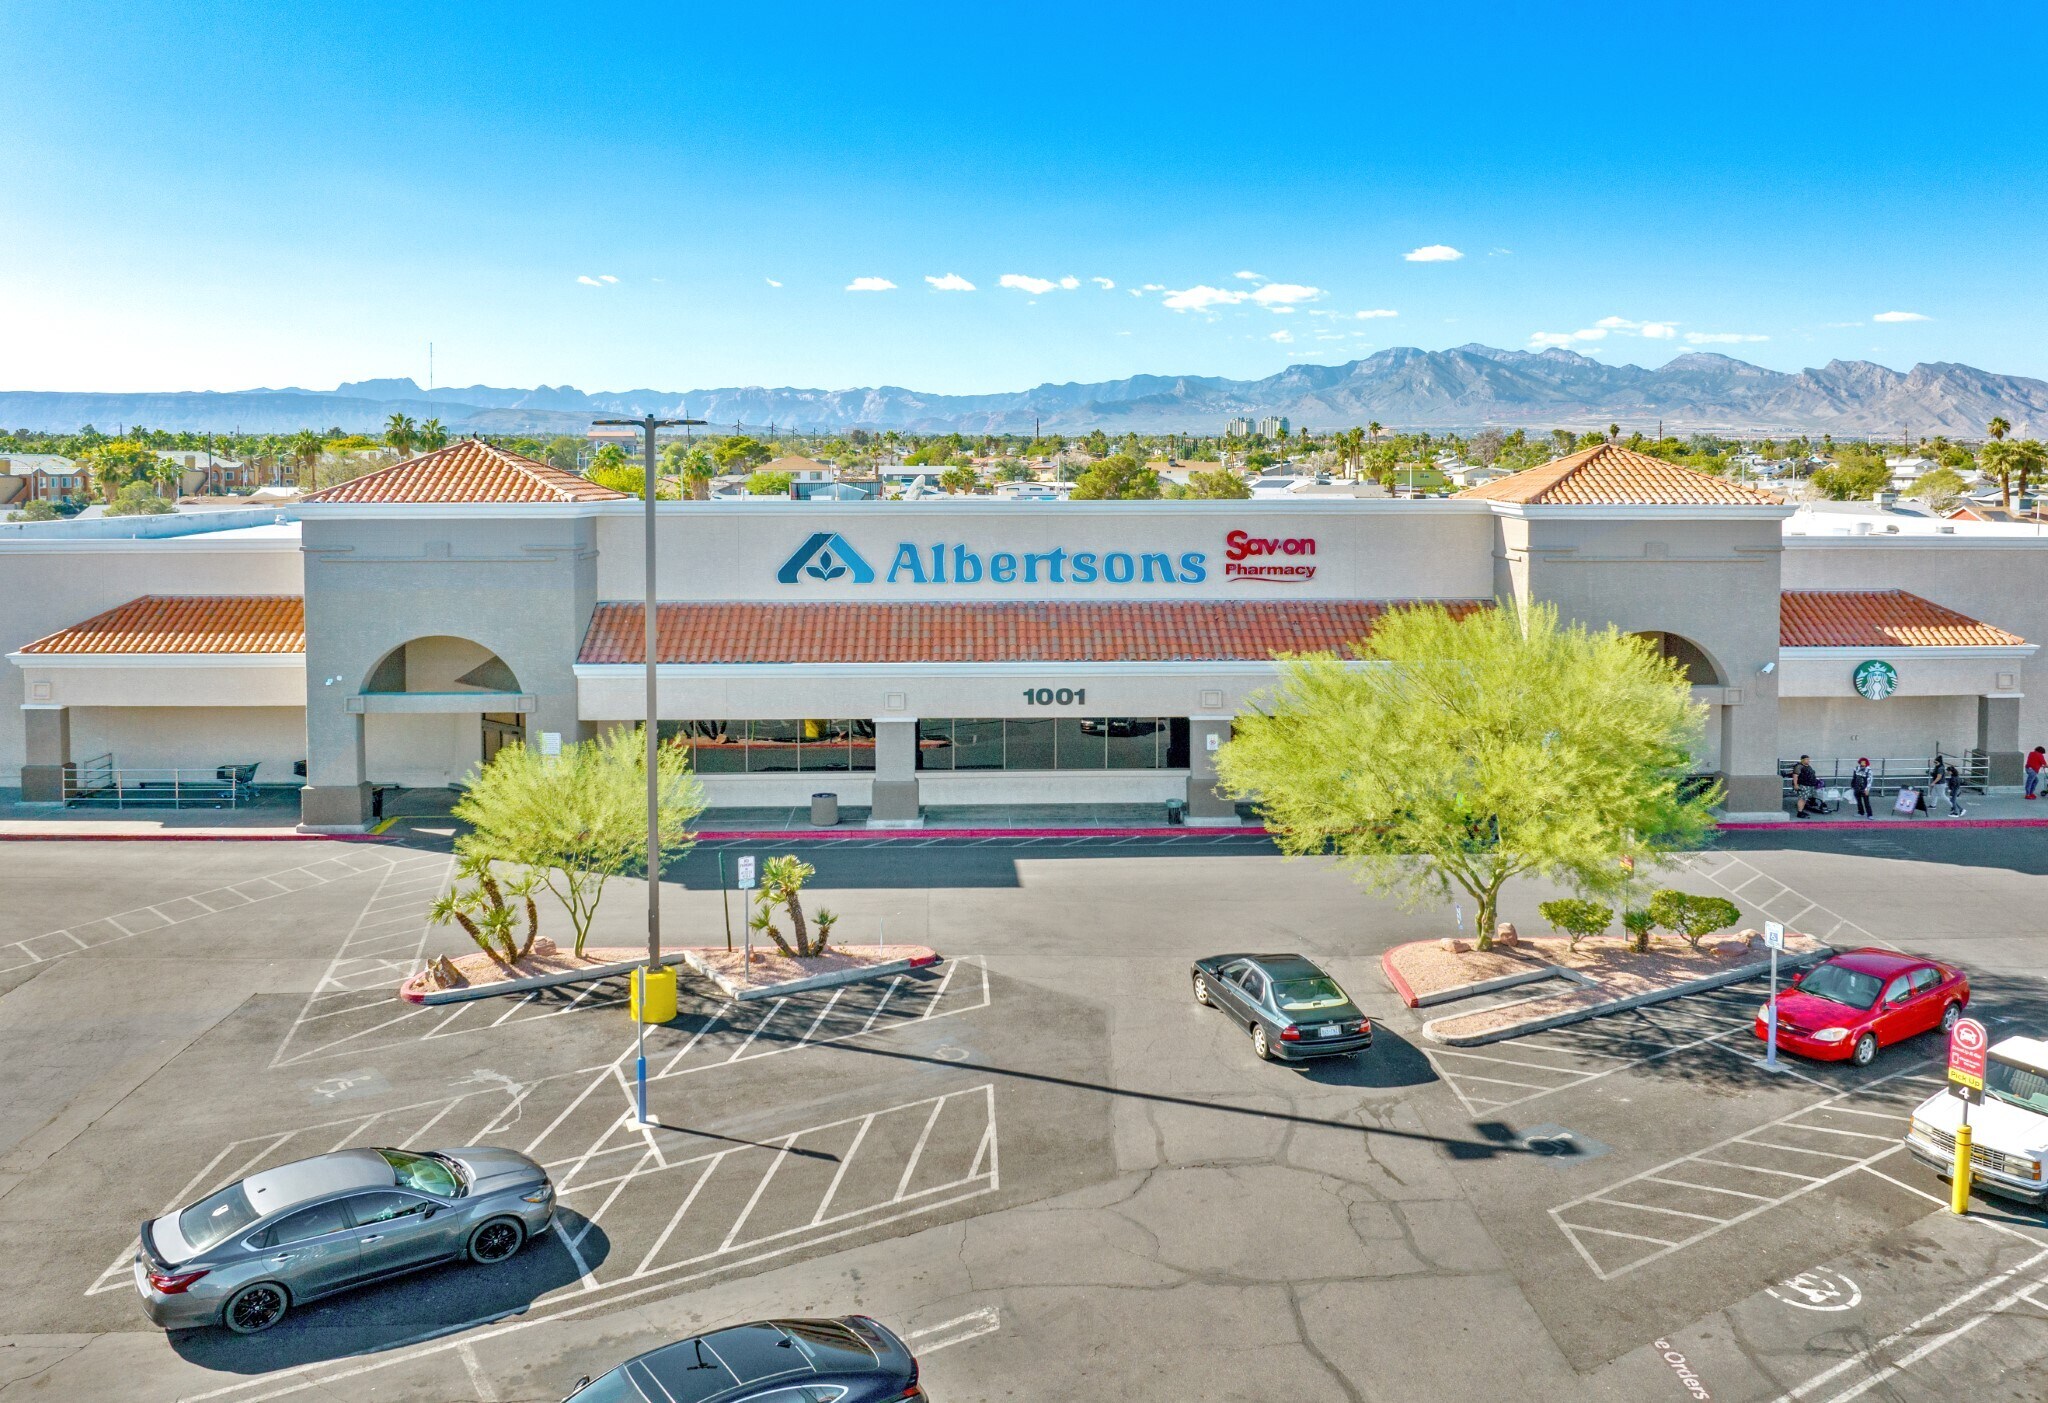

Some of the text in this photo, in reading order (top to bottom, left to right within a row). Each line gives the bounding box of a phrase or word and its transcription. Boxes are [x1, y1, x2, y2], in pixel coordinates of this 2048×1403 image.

[886, 542, 1207, 584] Albertsons
[1225, 563, 1317, 578] Pharmacy
[1022, 687, 1086, 706] 1001
[1950, 1070, 1967, 1082] Pick
[1958, 1086, 1970, 1100] 4
[1663, 1351, 1711, 1400] Orders
